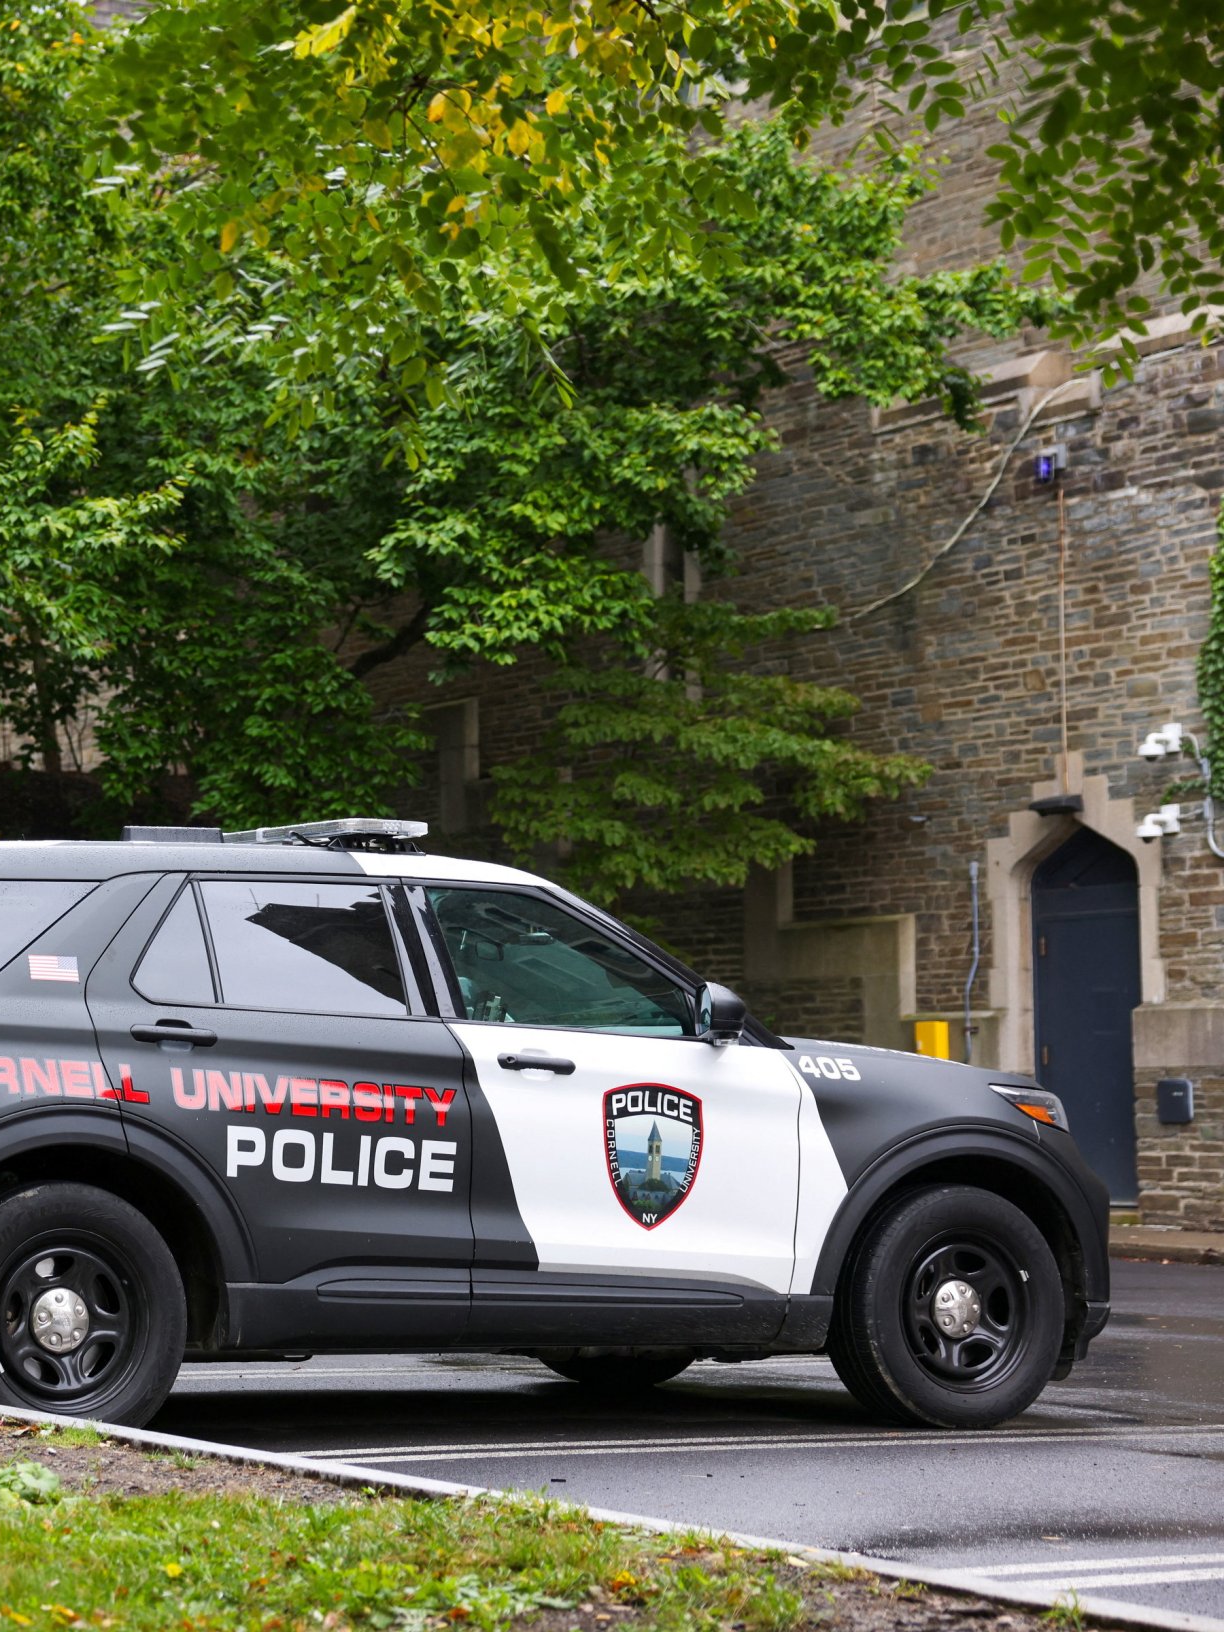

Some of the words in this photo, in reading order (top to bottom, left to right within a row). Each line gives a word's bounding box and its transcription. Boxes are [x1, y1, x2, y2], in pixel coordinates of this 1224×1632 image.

[169, 1066, 458, 1127] UNIVERSITY
[798, 1055, 861, 1081] 405
[611, 1090, 693, 1122] POLICE
[226, 1125, 457, 1192] POLICE
[606, 1119, 622, 1187] CORNELL
[679, 1127, 701, 1193] UNIVERSITY
[642, 1213, 658, 1224] NY
